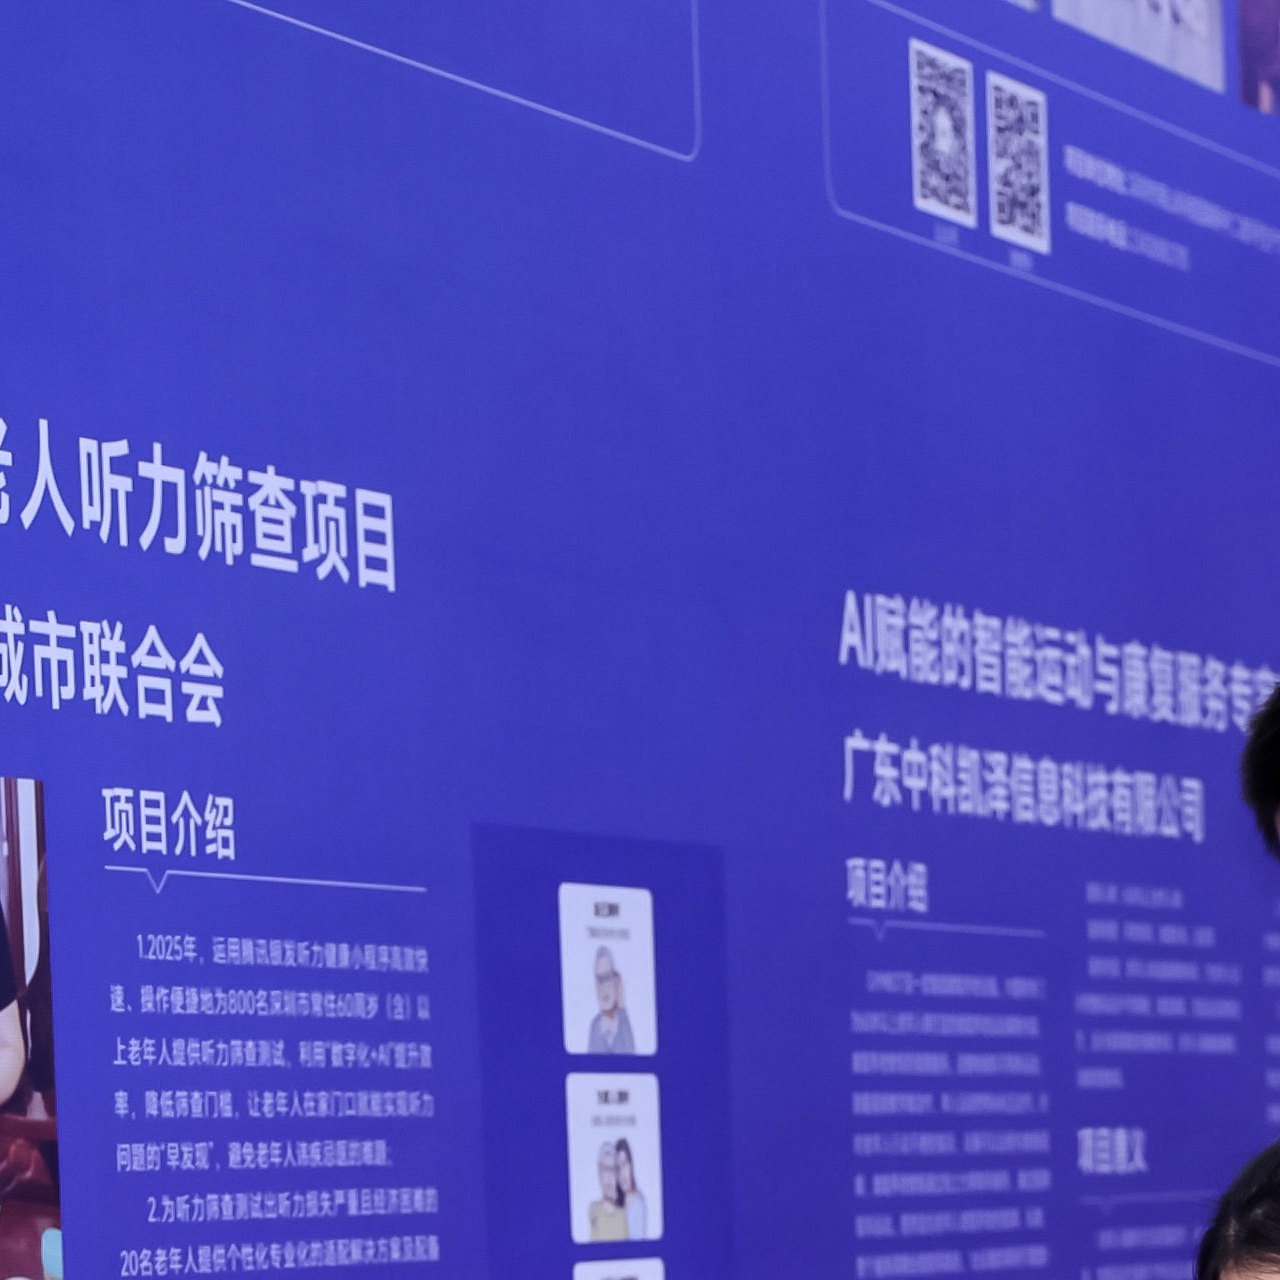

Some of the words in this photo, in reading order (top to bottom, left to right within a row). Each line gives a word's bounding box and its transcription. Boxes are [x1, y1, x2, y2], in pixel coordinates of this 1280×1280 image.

[102, 787, 235, 860] 项目介绍
[846, 857, 928, 914] 项目介绍
